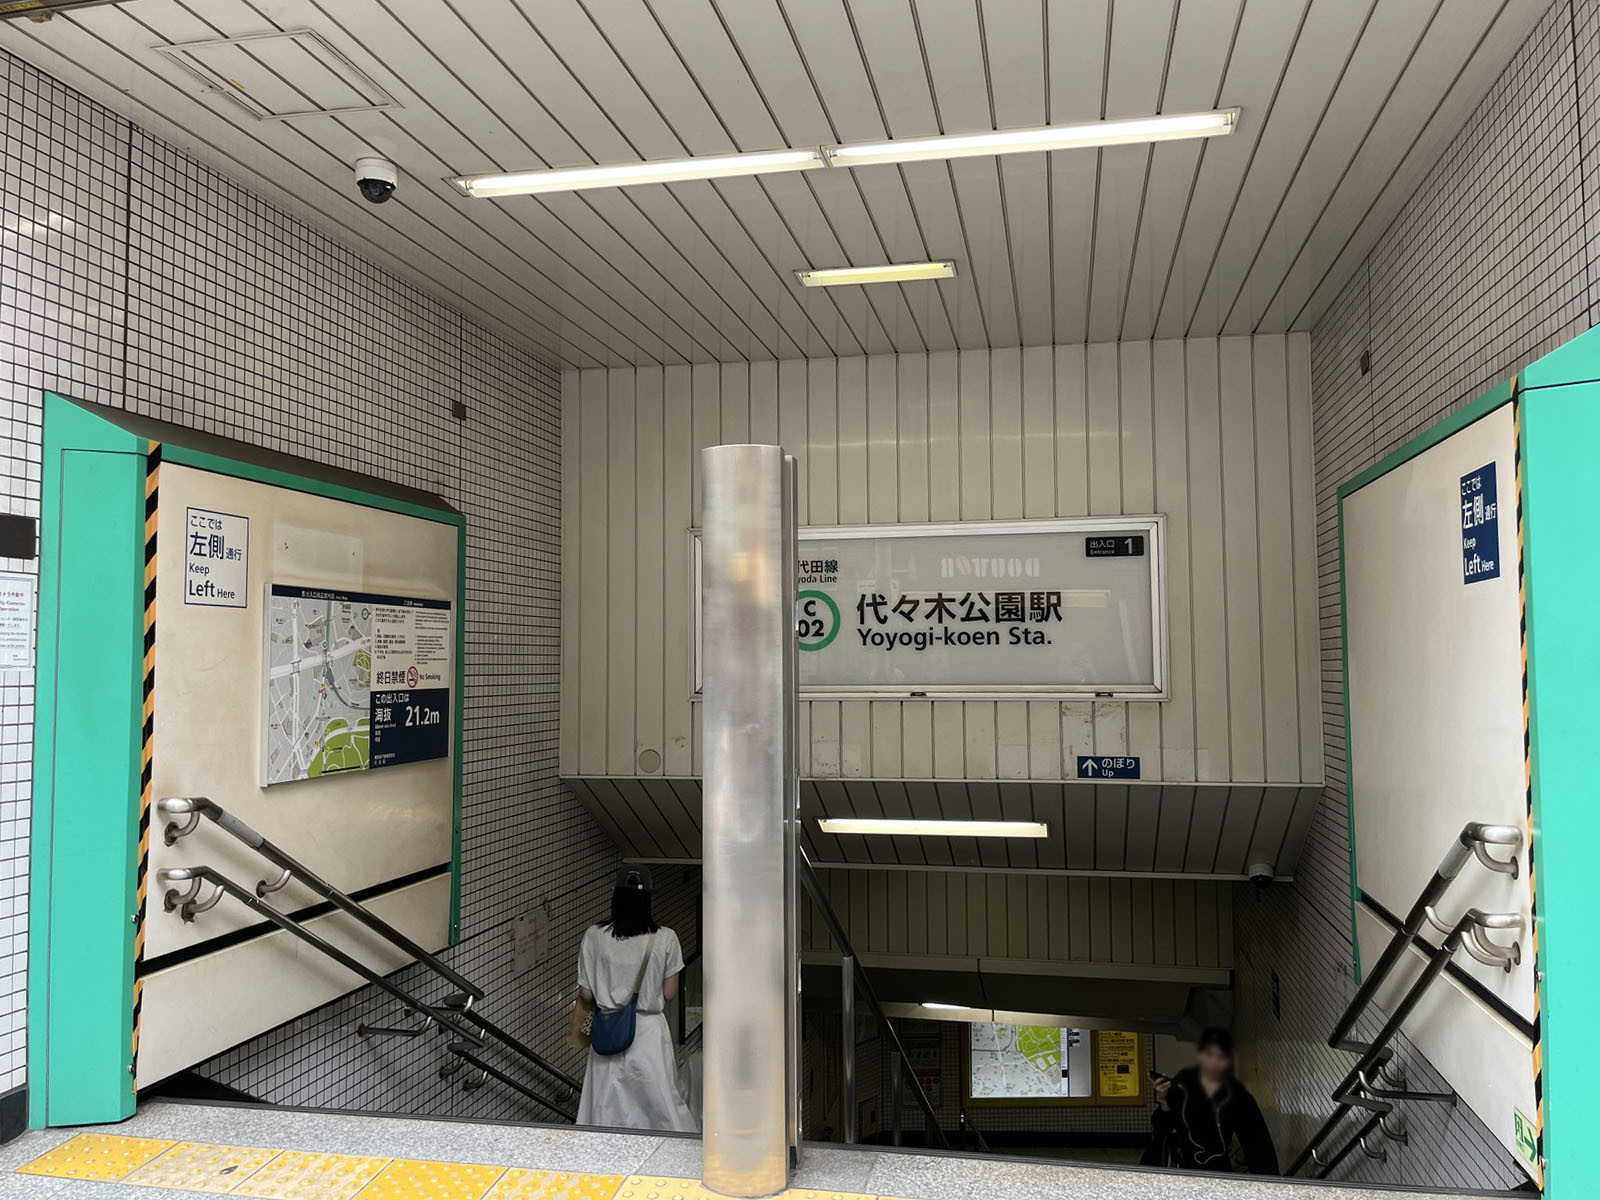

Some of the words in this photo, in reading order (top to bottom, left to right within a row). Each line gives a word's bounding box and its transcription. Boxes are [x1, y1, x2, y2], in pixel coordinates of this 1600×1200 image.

[1461, 476, 1481, 495] ここでは
[191, 515, 222, 530] ここでは
[1090, 540, 1115, 549] 出入口
[1124, 538, 1133, 554] 1
[1463, 537, 1476, 550] Keep
[189, 562, 210, 576] Keep
[1464, 553, 1481, 576] Left
[1481, 560, 1494, 572] Here
[819, 575, 837, 583] Line
[189, 579, 215, 598] Left
[217, 588, 235, 599] Here
[803, 600, 816, 617] C
[857, 592, 1063, 625] 代々木公園駅
[798, 619, 825, 638] 02
[857, 626, 1000, 651] Yoyogi-koen
[1008, 626, 1052, 645] Sta.
[376, 671, 406, 685] 終日禁煙
[375, 693, 410, 704] この出入口は
[375, 707, 392, 722] 海抜
[405, 705, 440, 727] 21.2m
[1101, 758, 1136, 769] のぼり
[1101, 769, 1114, 777] Up
